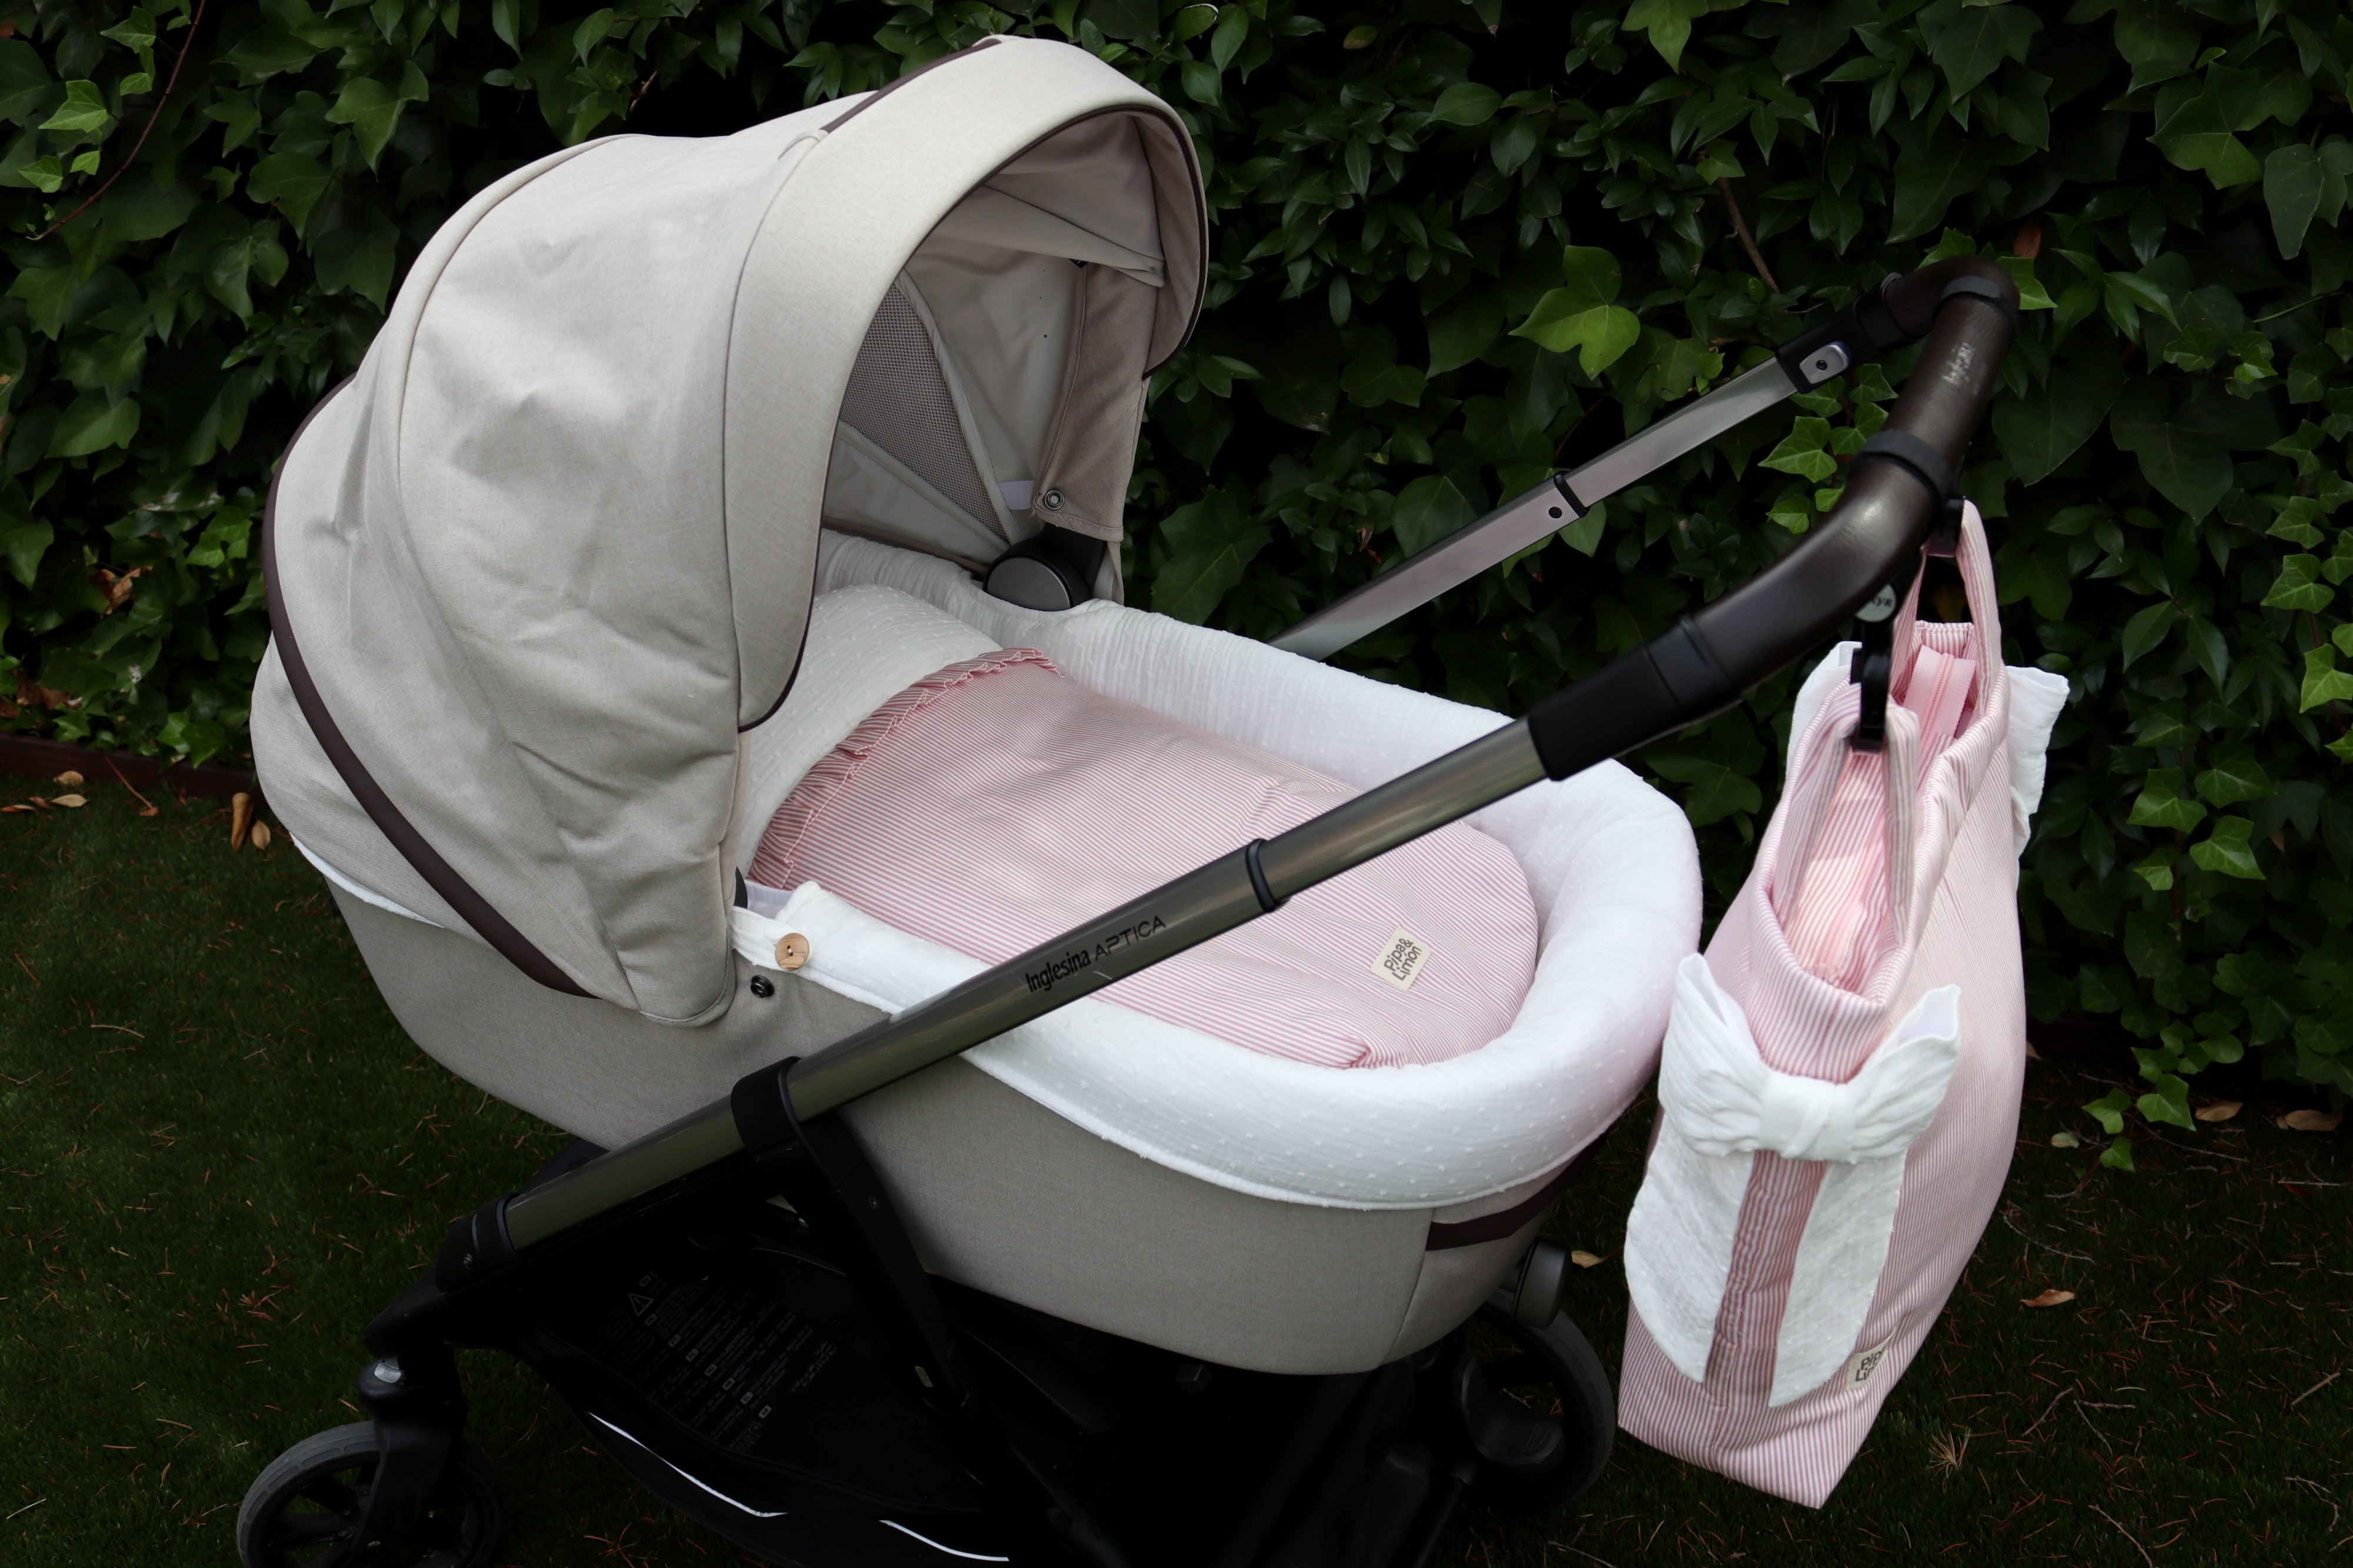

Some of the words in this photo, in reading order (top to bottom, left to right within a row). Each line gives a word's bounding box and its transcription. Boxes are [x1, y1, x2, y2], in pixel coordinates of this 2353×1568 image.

[1025, 949, 1091, 992] Inglesina
[1095, 915, 1166, 961] APTICA
[1392, 946, 1422, 981] Limón
